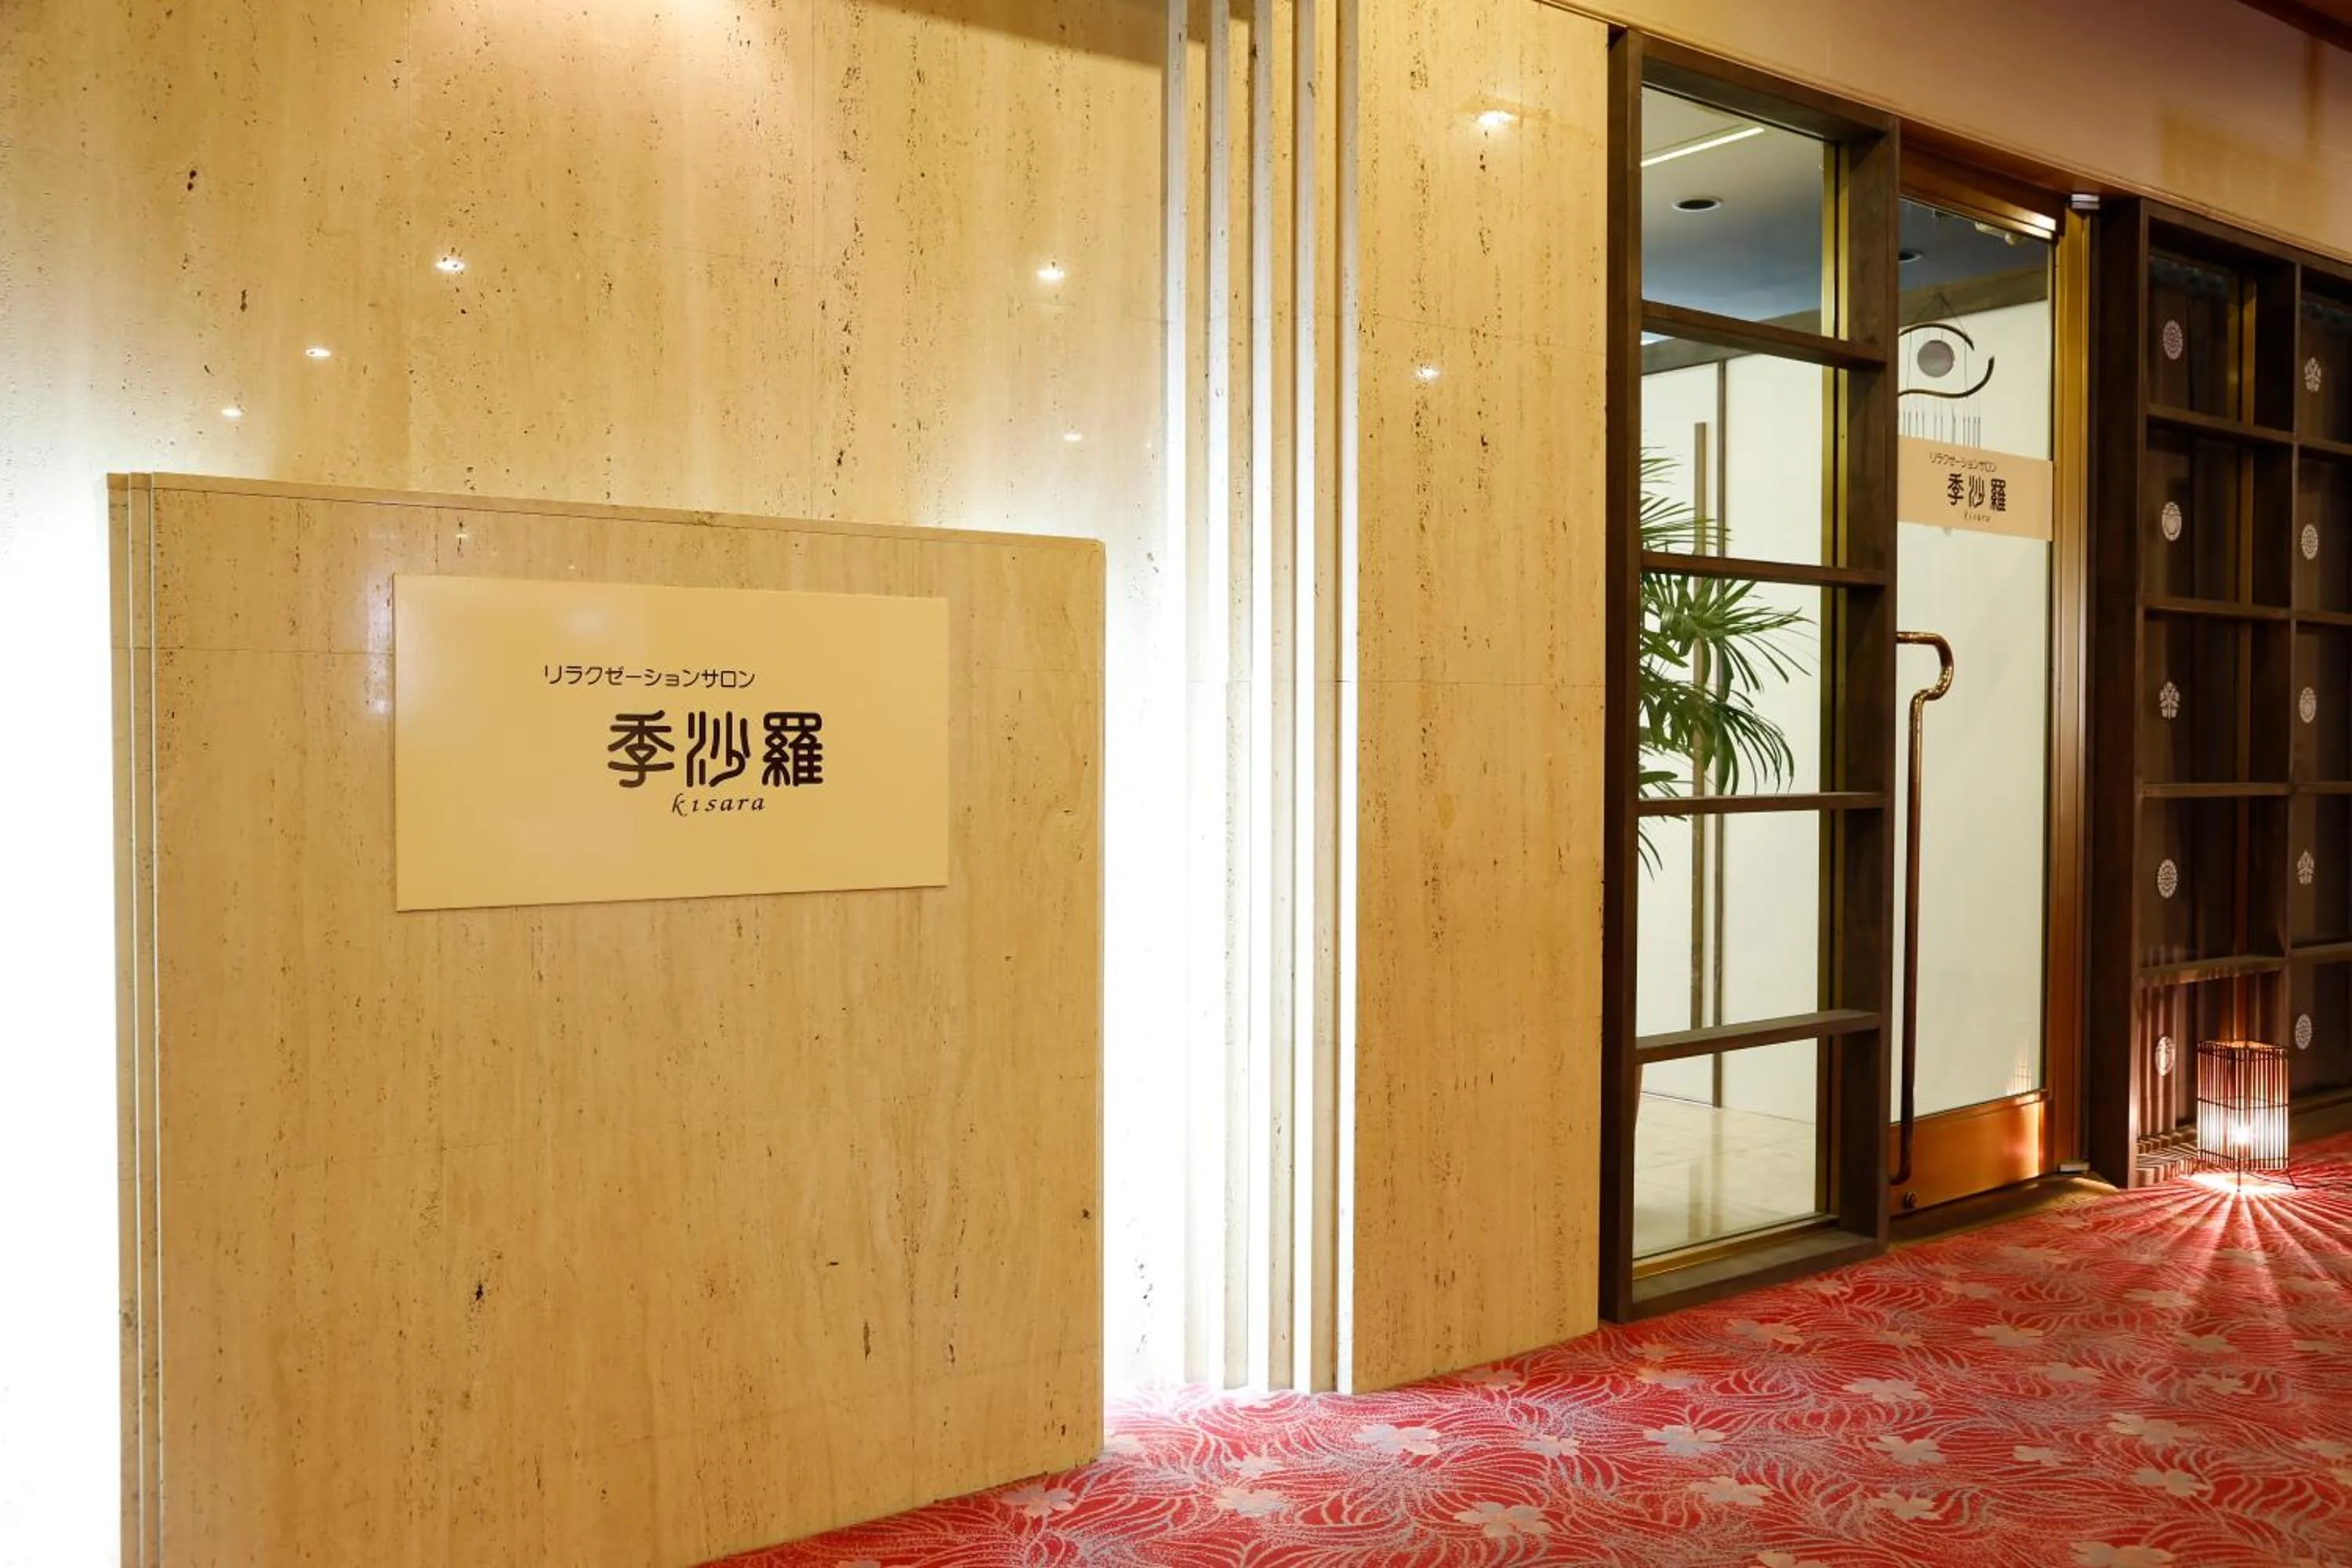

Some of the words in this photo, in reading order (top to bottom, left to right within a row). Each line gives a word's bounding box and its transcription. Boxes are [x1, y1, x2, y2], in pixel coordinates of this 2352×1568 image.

[1947, 473, 2006, 512] 季沙羅
[544, 664, 756, 688] リラクゼーションサロン
[607, 710, 824, 788] 季沙羅
[671, 793, 766, 817] kisara
